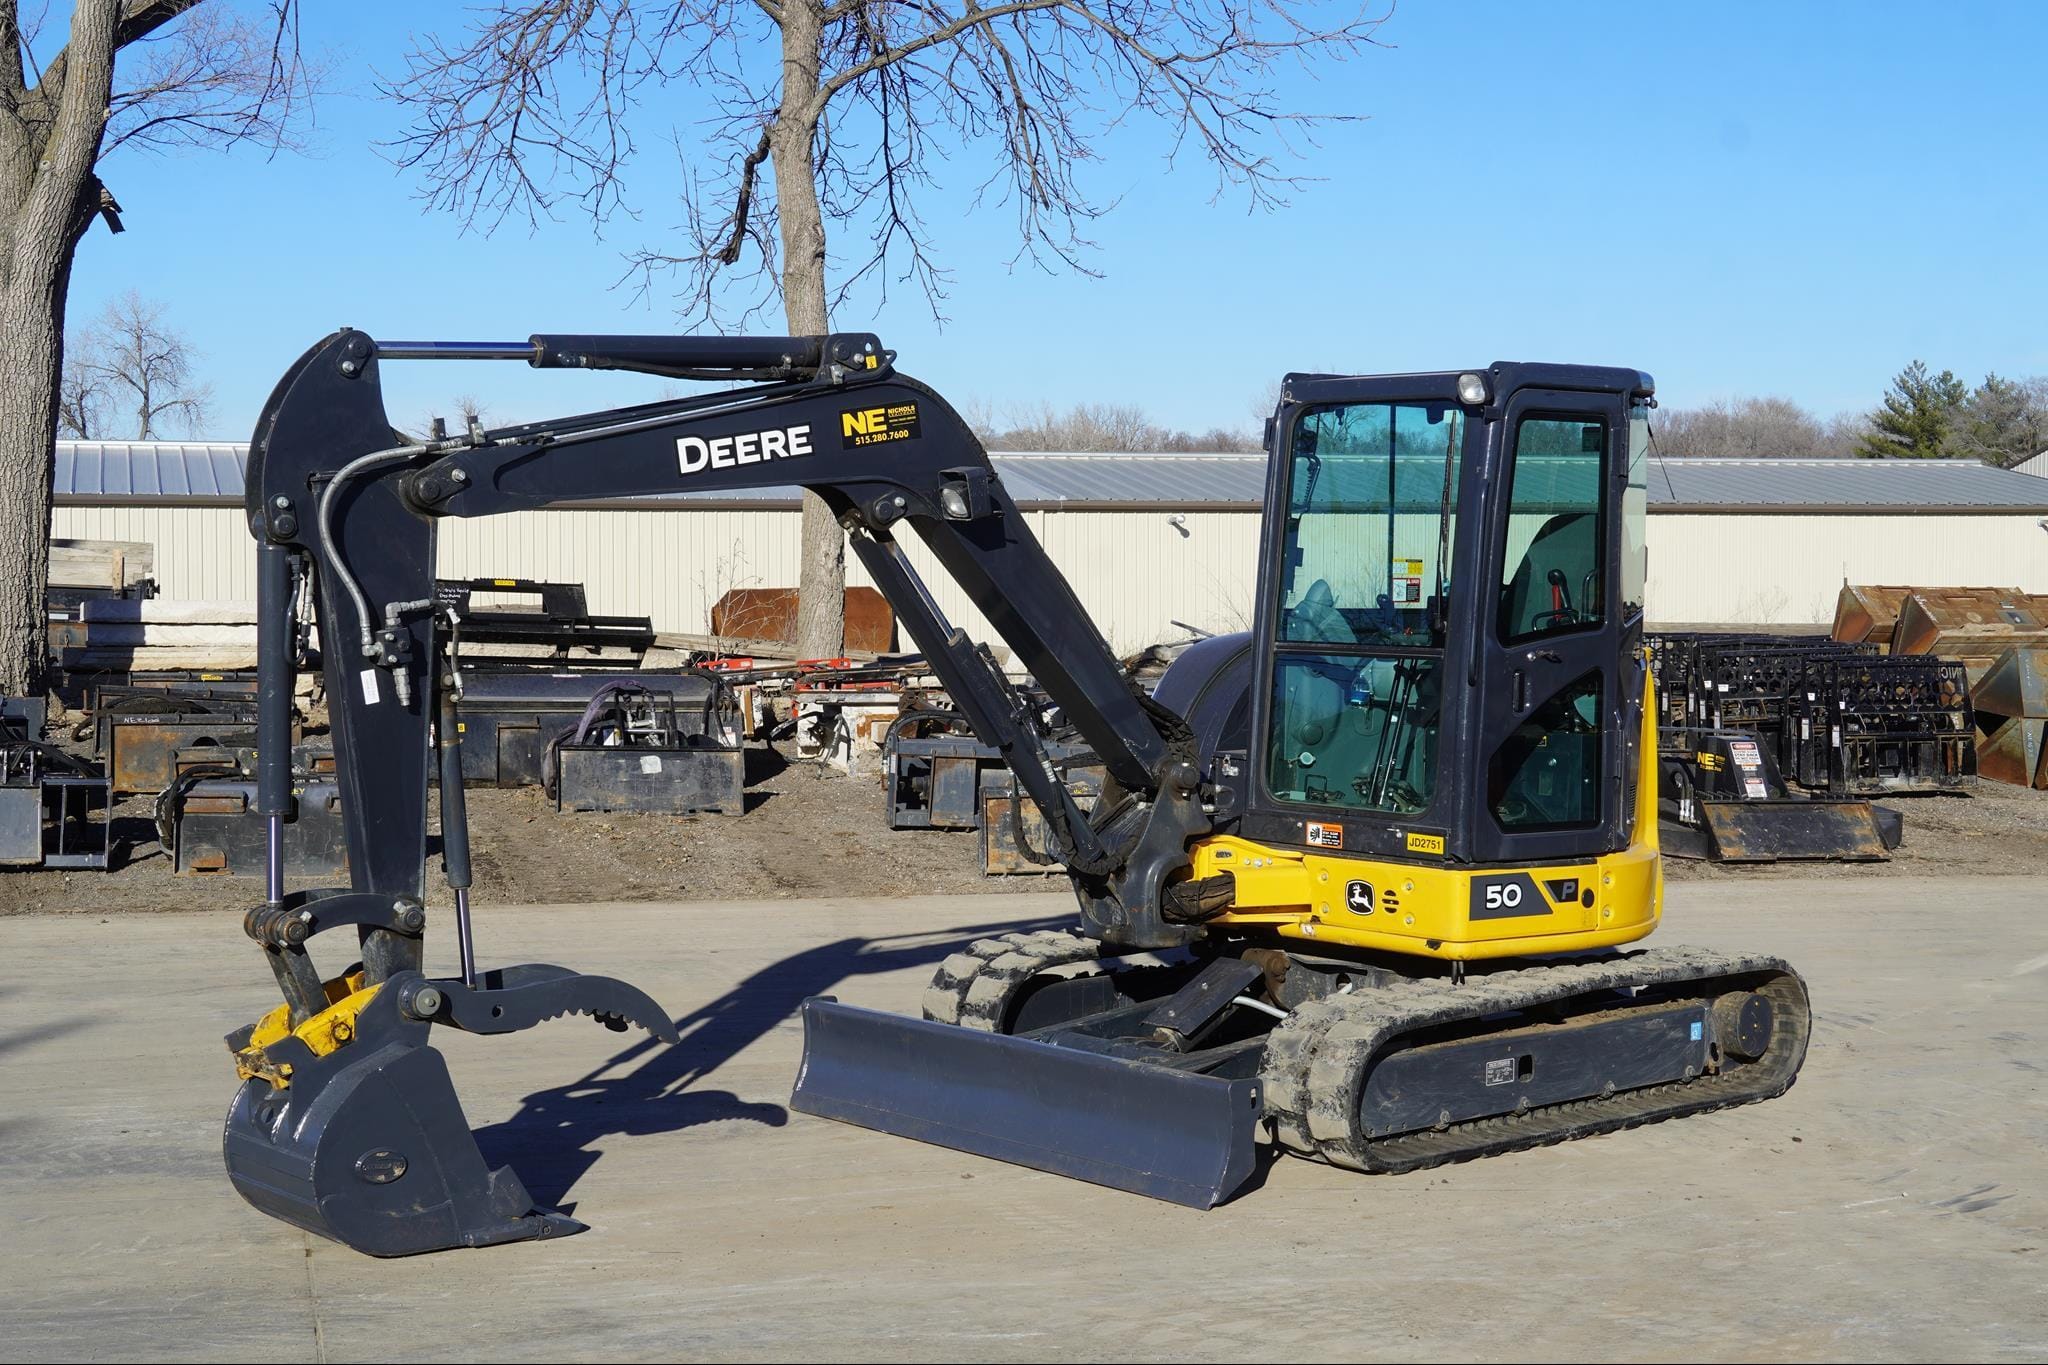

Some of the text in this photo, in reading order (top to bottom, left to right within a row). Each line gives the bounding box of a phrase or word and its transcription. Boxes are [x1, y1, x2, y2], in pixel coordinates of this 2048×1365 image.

[888, 405, 915, 414] NICHOLS
[842, 408, 887, 437] NE
[855, 429, 909, 445] 515.280.7600
[676, 425, 813, 474] DEERE
[1409, 837, 1441, 850] JD2751
[1486, 881, 1576, 909] 50 P
